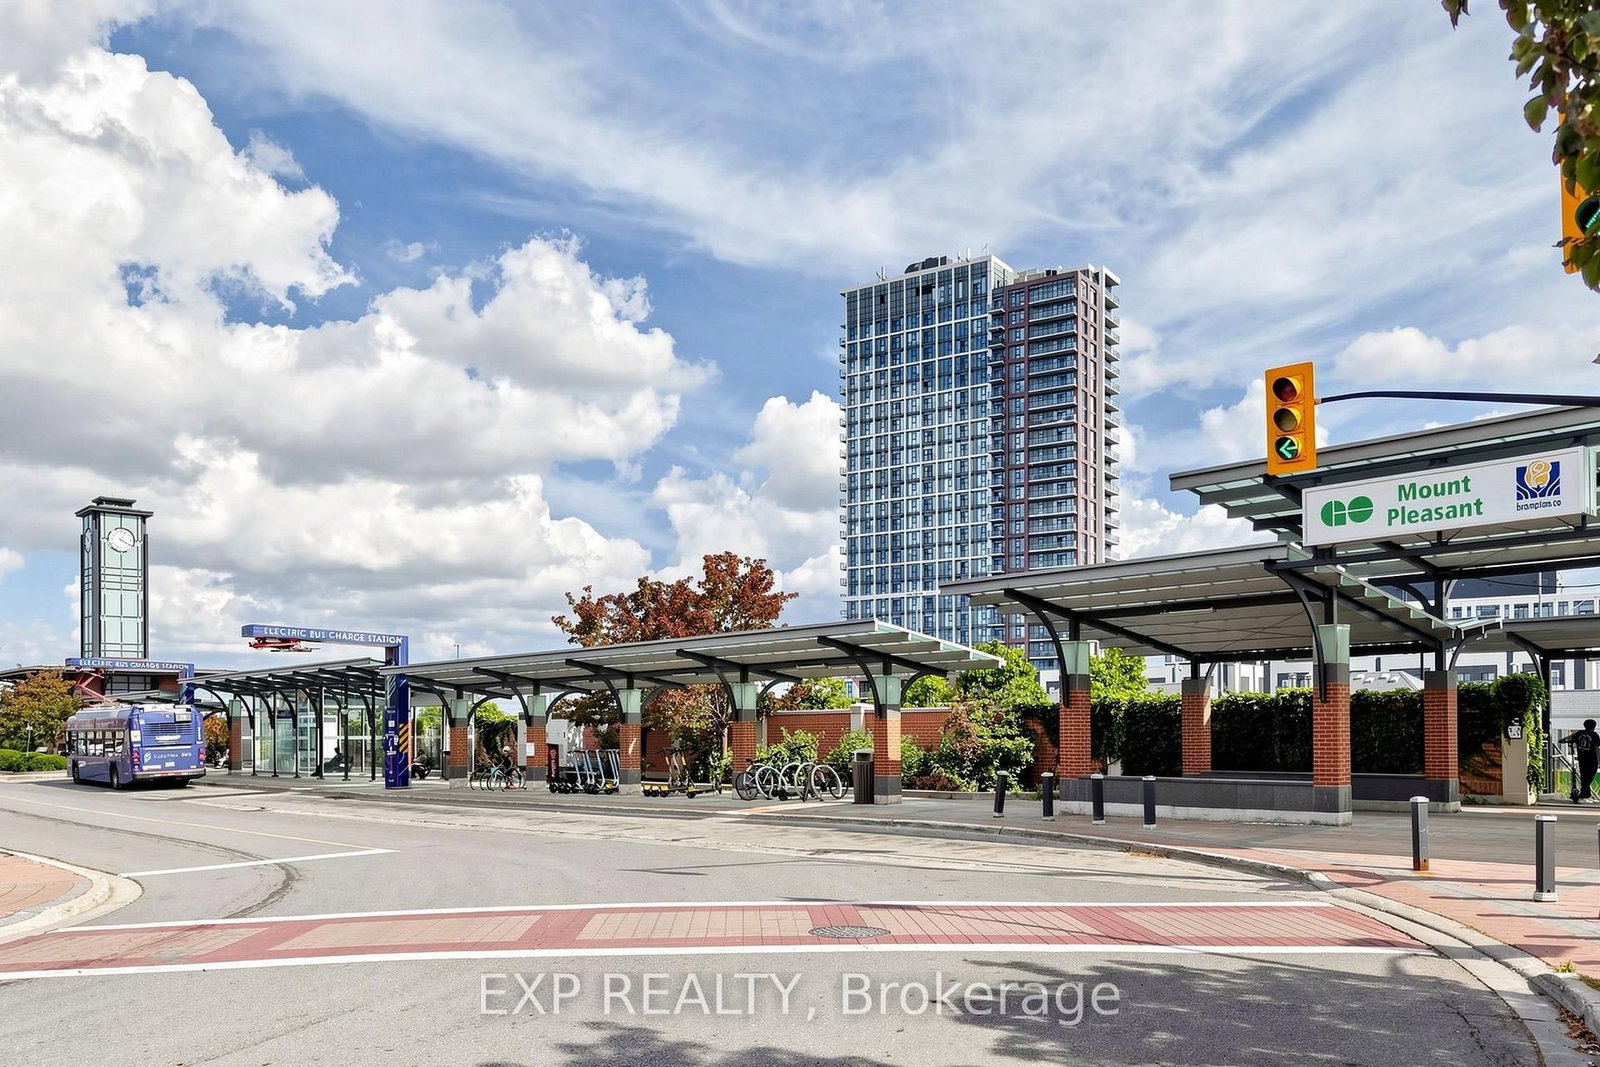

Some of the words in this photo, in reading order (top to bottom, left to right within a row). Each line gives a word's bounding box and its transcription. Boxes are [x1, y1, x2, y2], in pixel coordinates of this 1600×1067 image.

[1397, 475, 1471, 502] Mount
[1387, 497, 1483, 527] Pleasant
[264, 626, 307, 638] ELECTRIC
[310, 630, 326, 639] BUS
[329, 631, 365, 642] CHARGE
[368, 635, 403, 644] STATION
